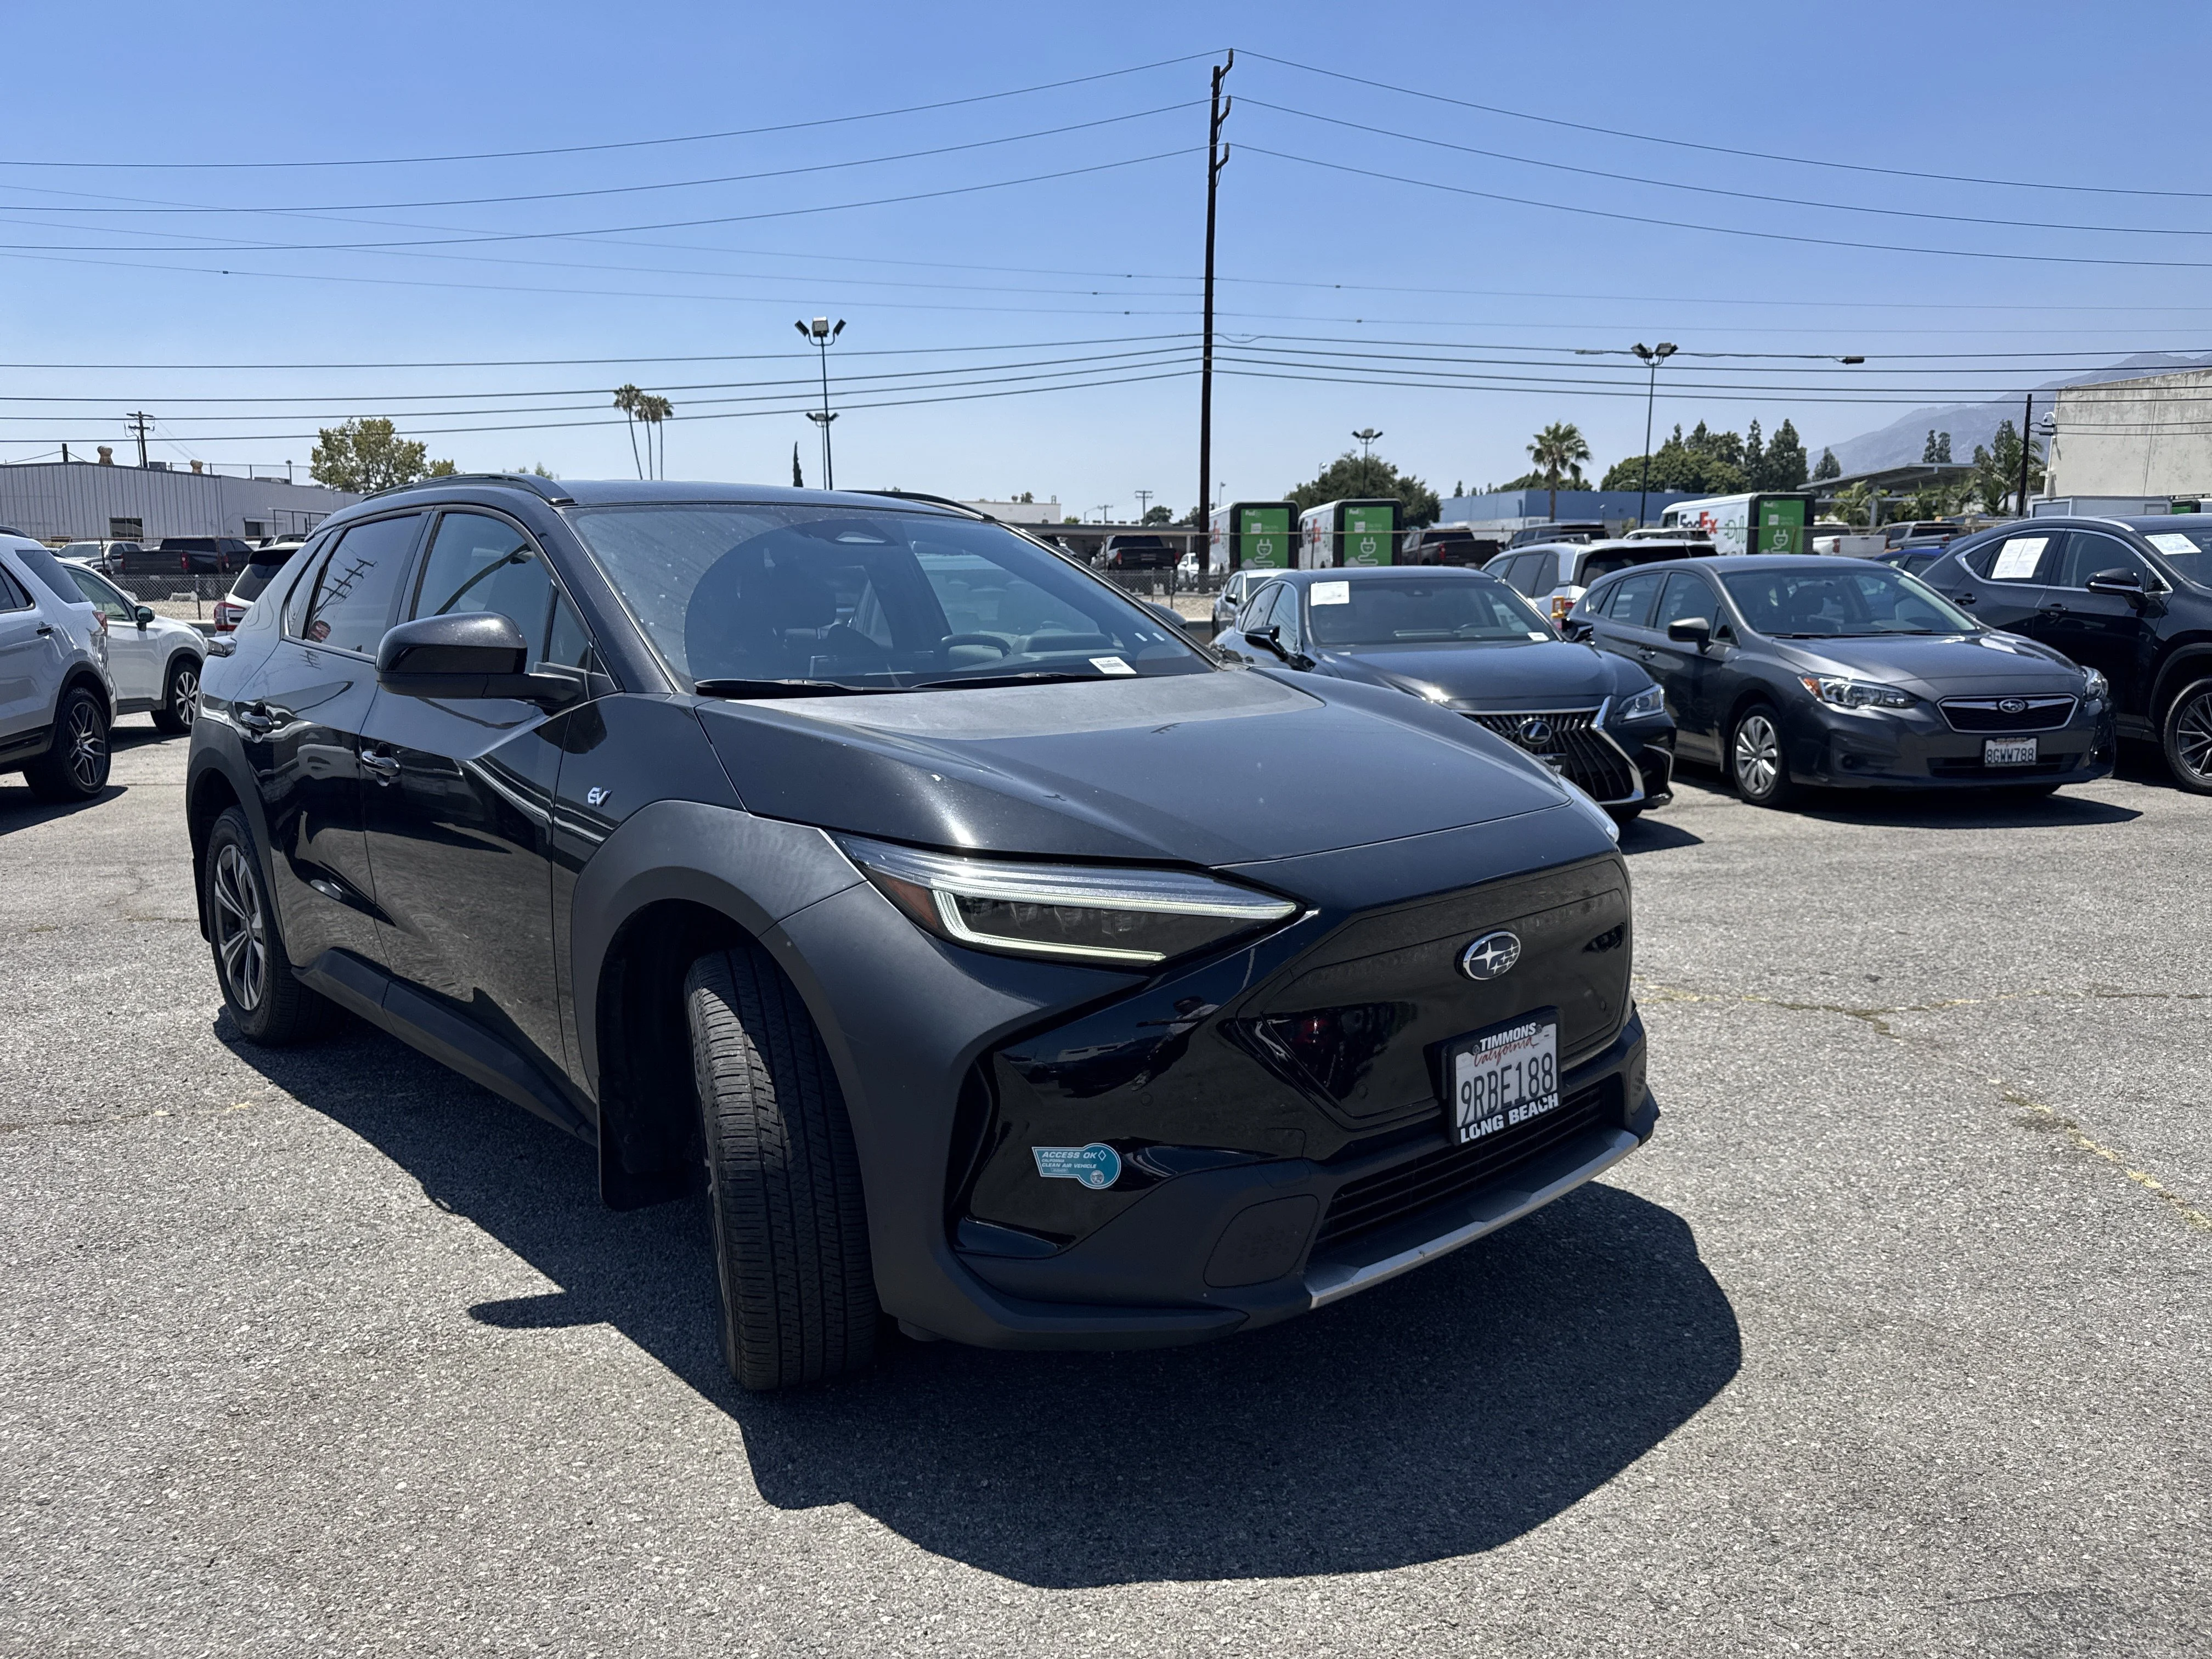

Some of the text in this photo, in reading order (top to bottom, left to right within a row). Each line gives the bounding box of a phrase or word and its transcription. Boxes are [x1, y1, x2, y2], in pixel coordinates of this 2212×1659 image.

[1987, 748, 2034, 763] 8GWW788
[588, 787, 612, 806] EV
[1474, 1036, 1539, 1067] California
[1480, 1022, 1536, 1052] TIMMONS
[1461, 1052, 1553, 1125] 9RBE188
[1460, 1093, 1559, 1143] LONG BEACH
